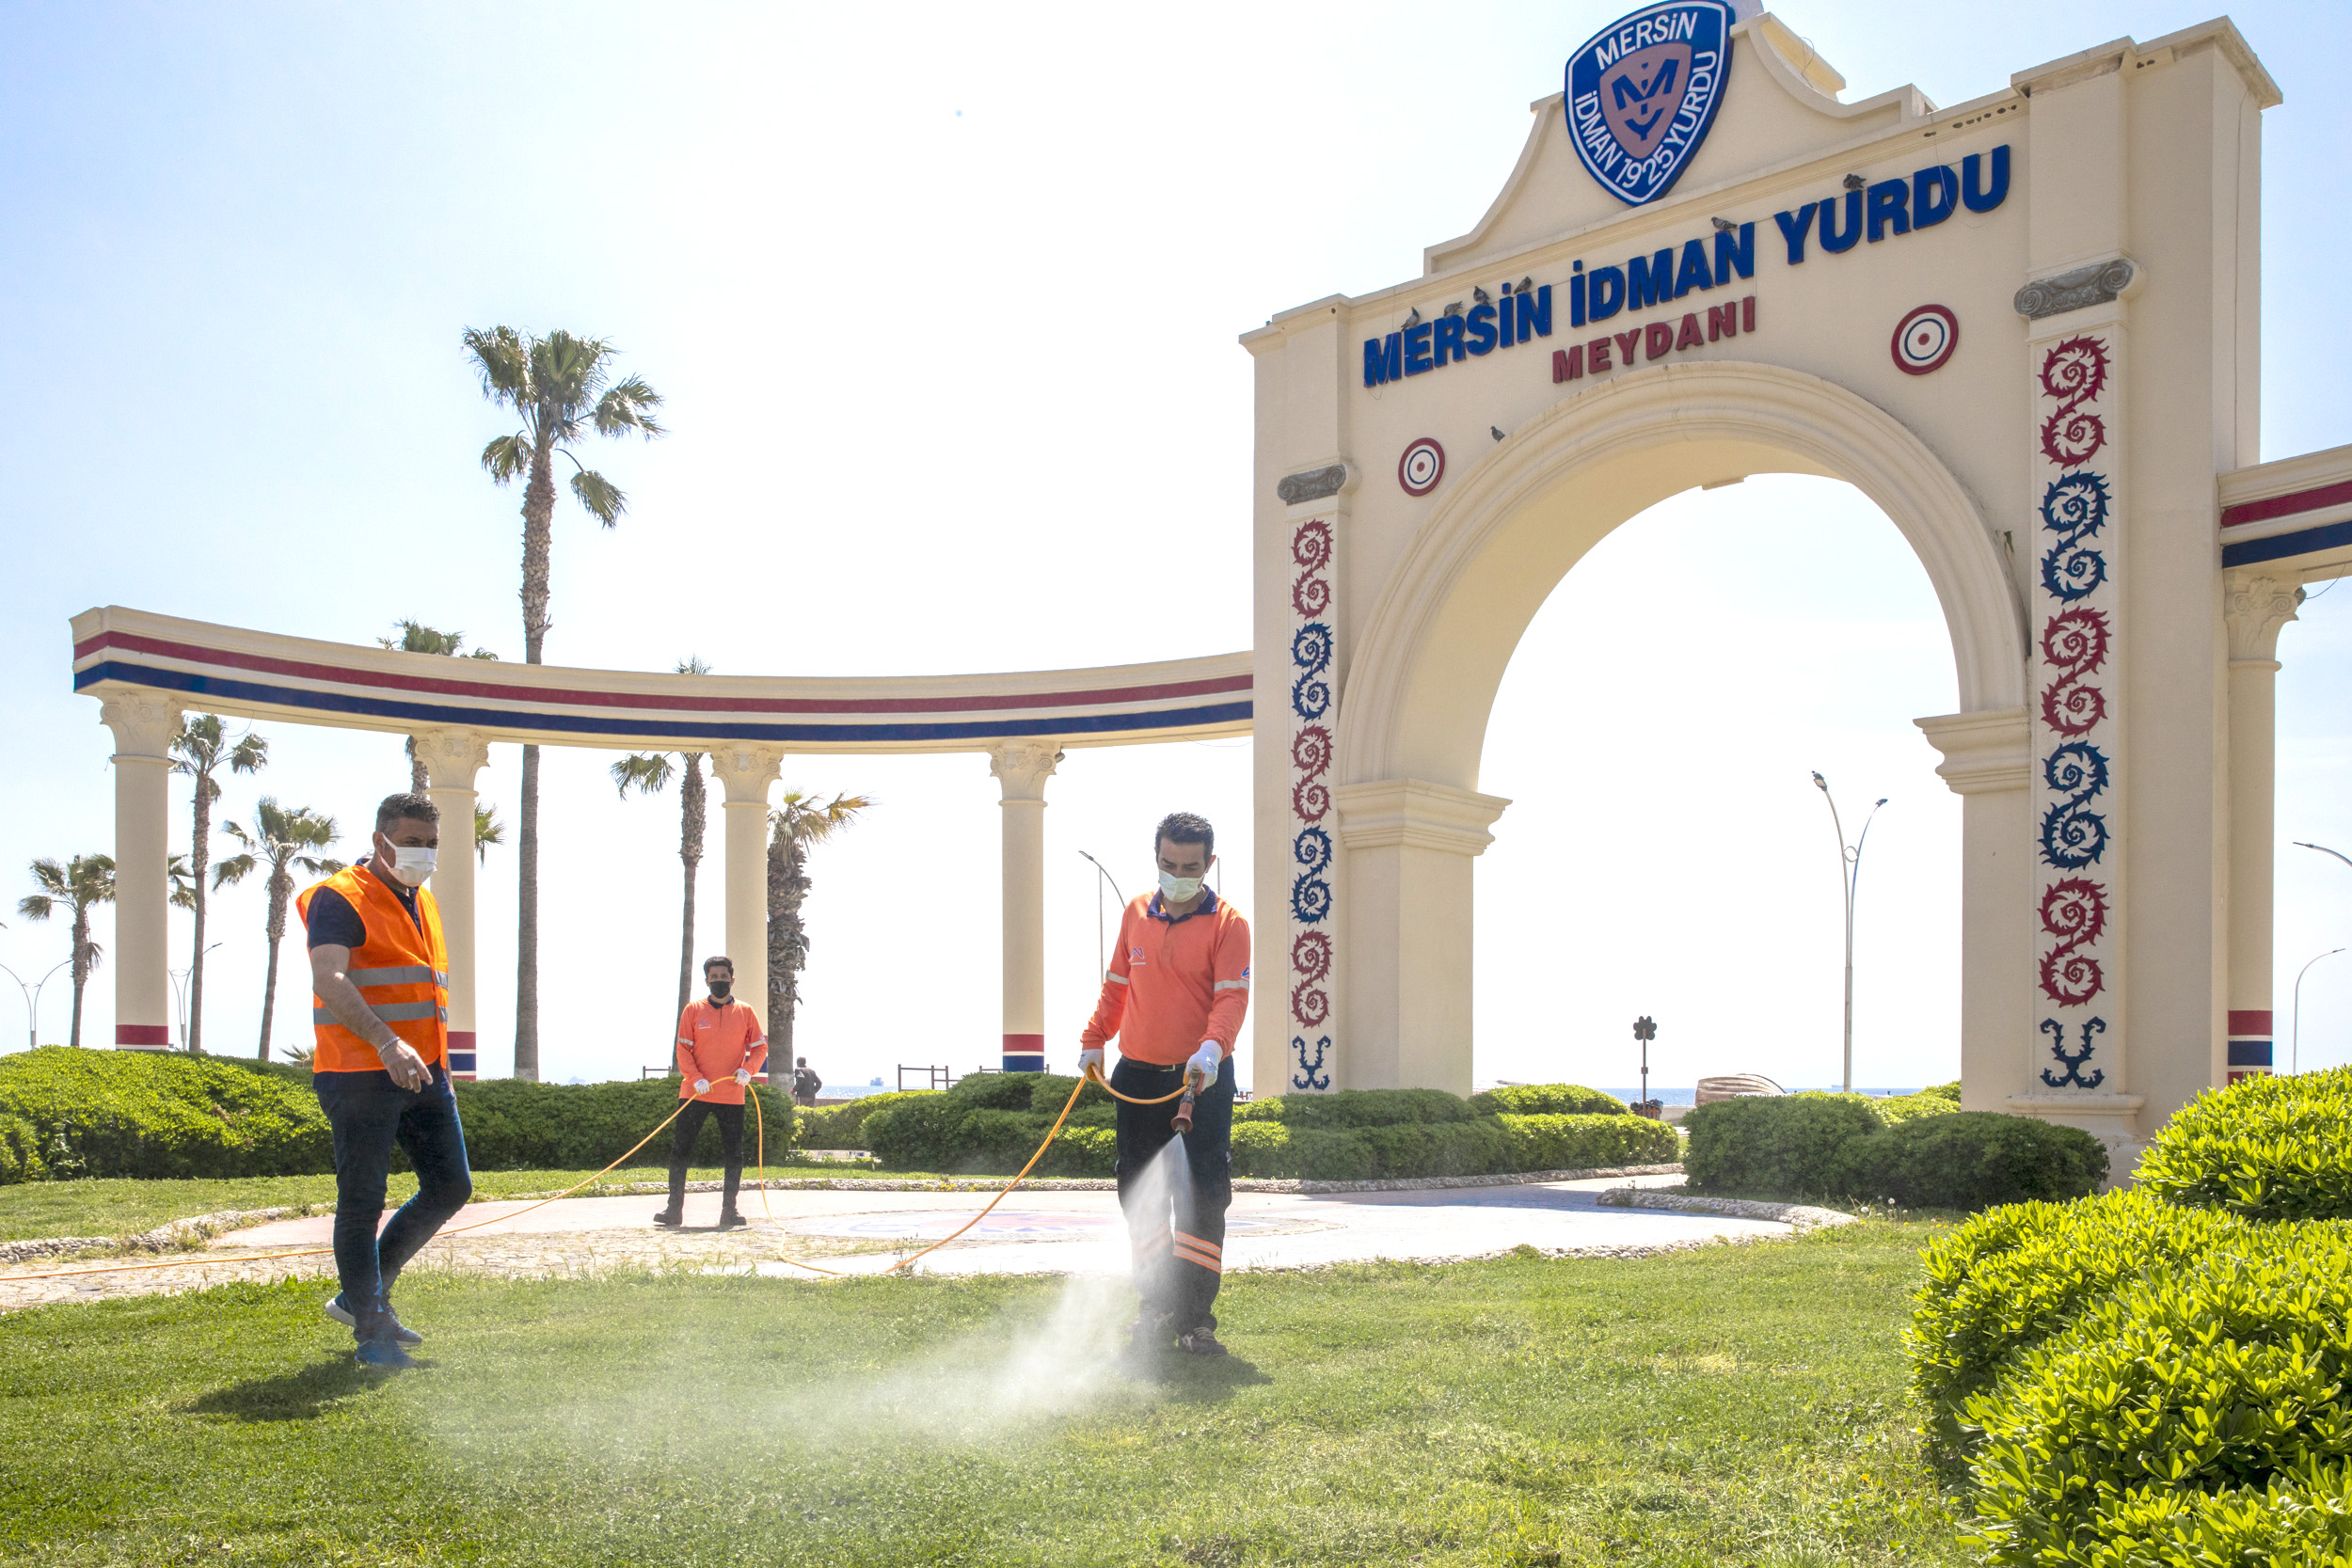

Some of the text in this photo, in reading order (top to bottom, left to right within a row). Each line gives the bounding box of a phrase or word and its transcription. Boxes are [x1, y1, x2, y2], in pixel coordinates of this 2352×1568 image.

[1615, 144, 1675, 188] 1925
[1663, 51, 1718, 147] YURDU
[1773, 144, 2010, 265] YURDU
[1552, 295, 1756, 384] MEYDANI
